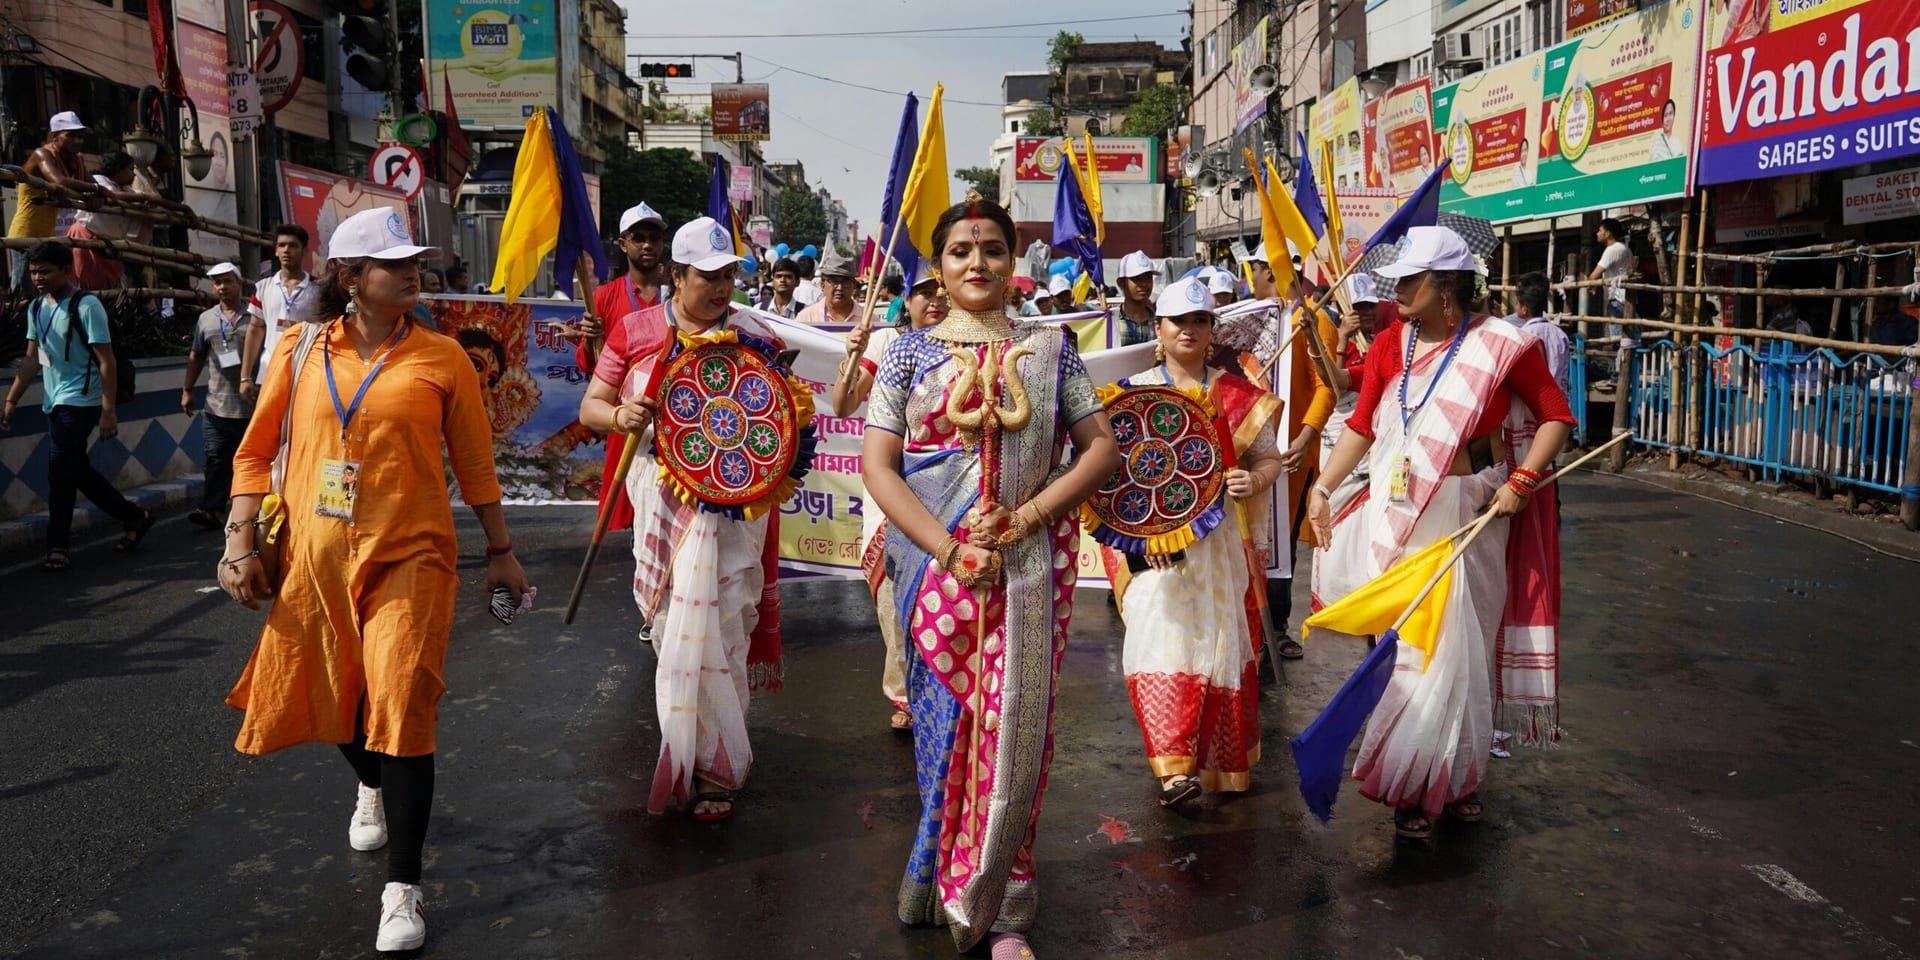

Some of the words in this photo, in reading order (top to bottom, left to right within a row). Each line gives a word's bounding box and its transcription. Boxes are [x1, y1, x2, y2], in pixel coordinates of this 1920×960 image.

[475, 25, 505, 33] BIMA
[474, 35, 507, 44] JYOTI
[487, 81, 501, 89] Get
[1704, 55, 1715, 143] COURTESY
[1758, 134, 1835, 170] SAREES
[1855, 116, 1920, 154] SUITS
[1876, 171, 1919, 188] SAKET
[1845, 191, 1892, 207] DENTAL
[1744, 228, 1776, 238] VINOD
